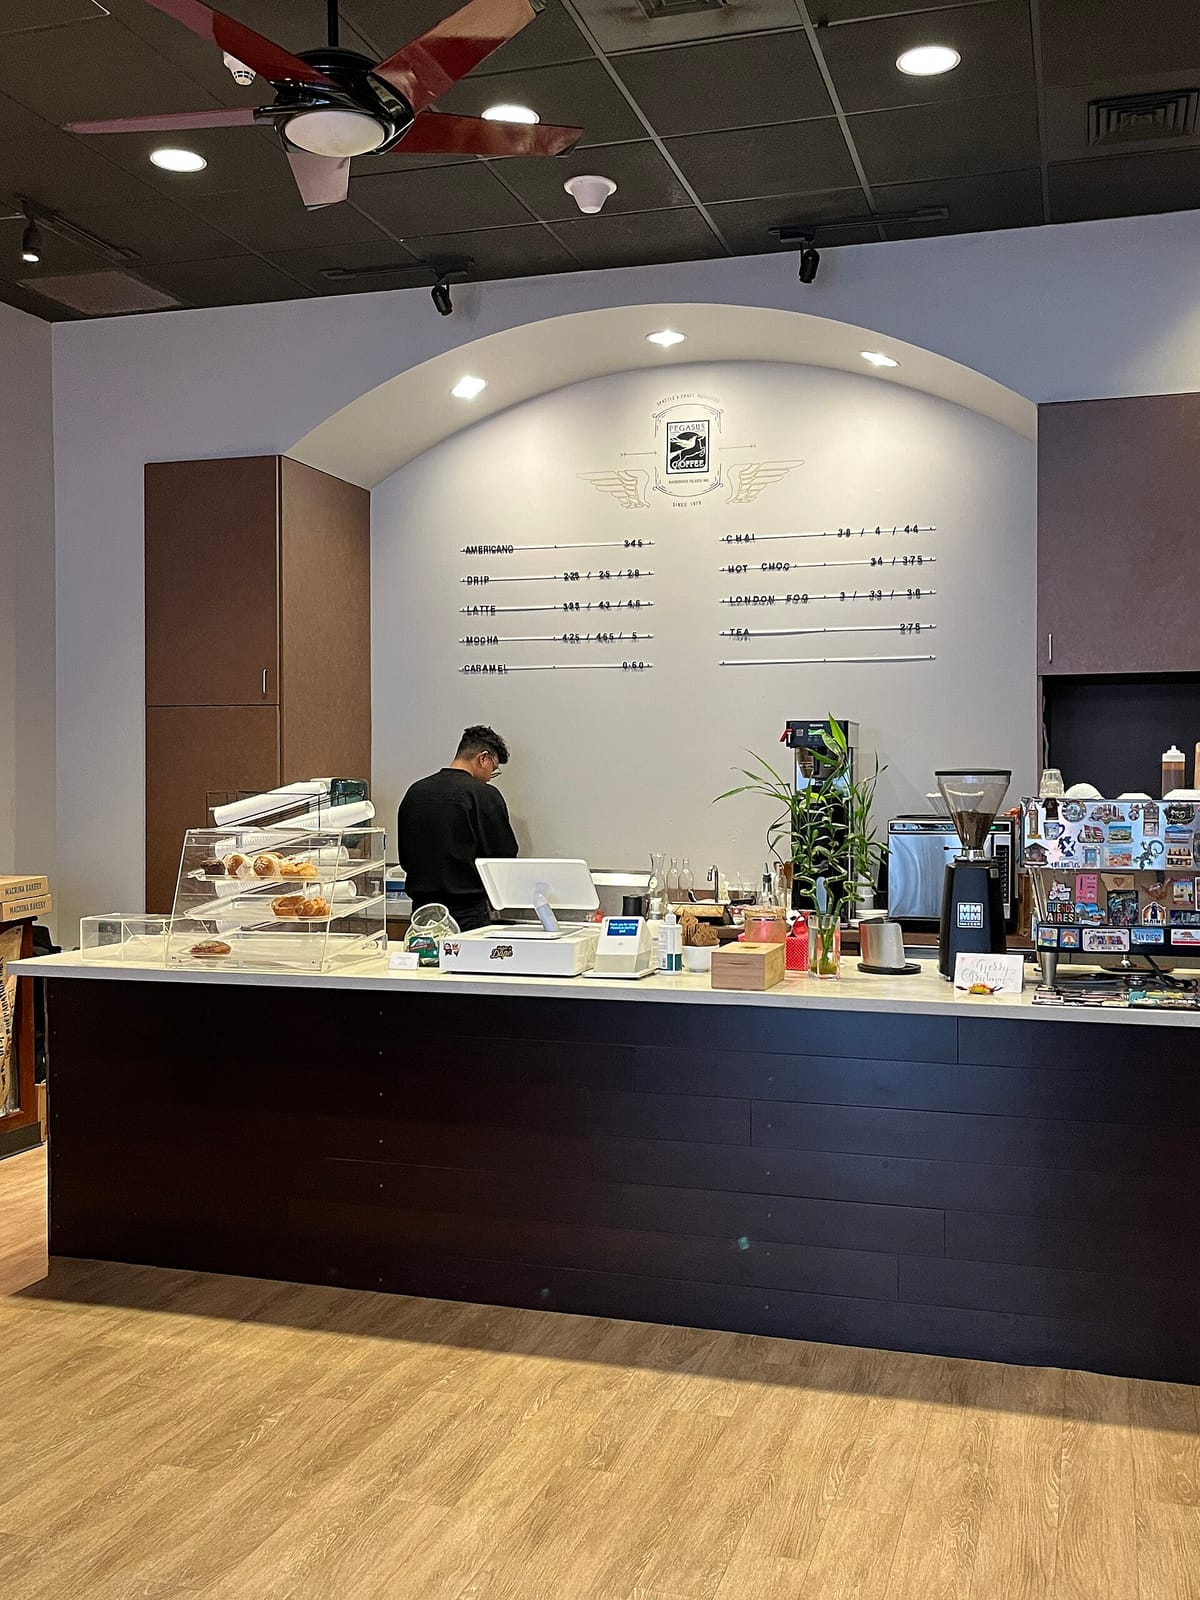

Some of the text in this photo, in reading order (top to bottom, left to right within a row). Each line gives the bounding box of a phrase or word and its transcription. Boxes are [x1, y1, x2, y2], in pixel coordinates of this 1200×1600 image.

[671, 460, 705, 469] COFFEE
[726, 533, 755, 542] CHAI
[465, 545, 514, 555] AMERICANO
[728, 564, 748, 573] HOT
[467, 576, 490, 586] DRIP
[729, 595, 776, 604] LONDON
[786, 593, 809, 603] FOG
[467, 605, 496, 615] LATTE
[729, 628, 750, 637] TEA
[466, 635, 498, 645] MOCHA
[464, 664, 509, 673] CARAMEL
[26, 882, 42, 892] BAKERY
[30, 901, 46, 911] BAKERY
[1048, 903, 1075, 912] BUENOS
[1047, 912, 1075, 922] AIRES
